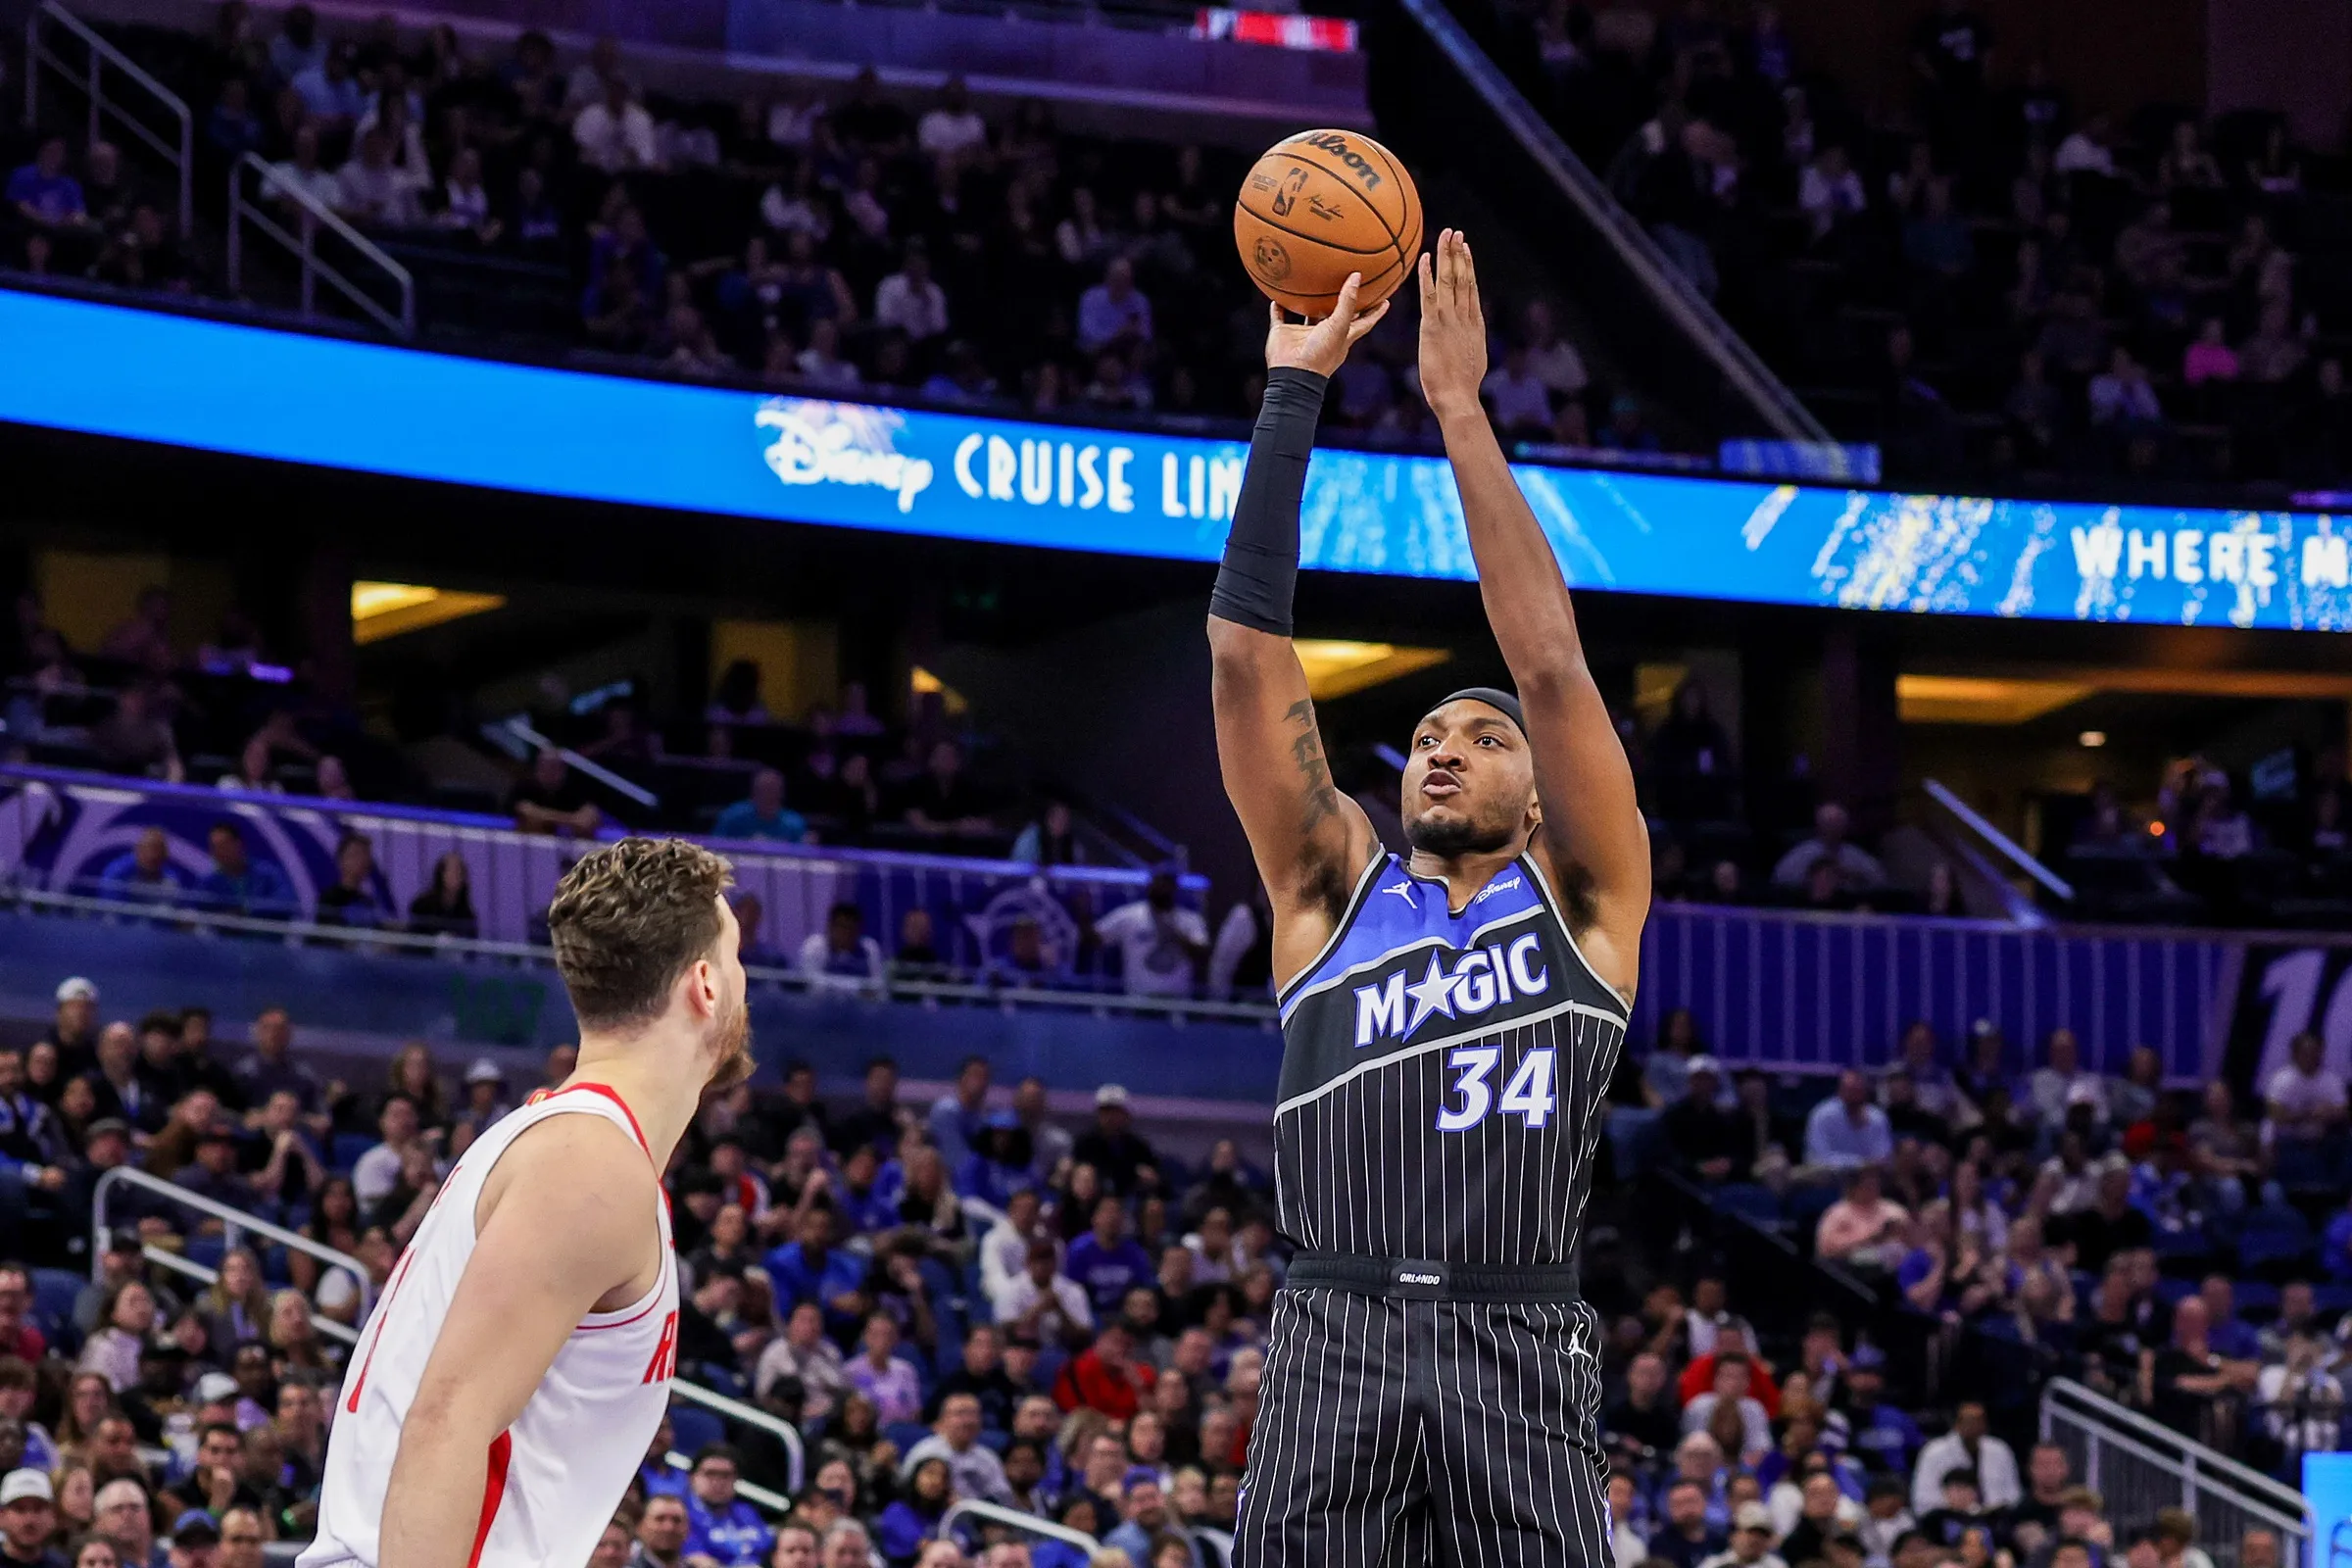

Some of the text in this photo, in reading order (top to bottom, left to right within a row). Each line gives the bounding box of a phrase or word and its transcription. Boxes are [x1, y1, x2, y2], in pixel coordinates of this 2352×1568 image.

[755, 409, 1243, 521] Disney CRUISE LIN
[2070, 525, 2352, 588] WHERE M
[1473, 876, 1521, 905] Disney
[1436, 1045, 1556, 1132] 34
[643, 1309, 678, 1385] R
